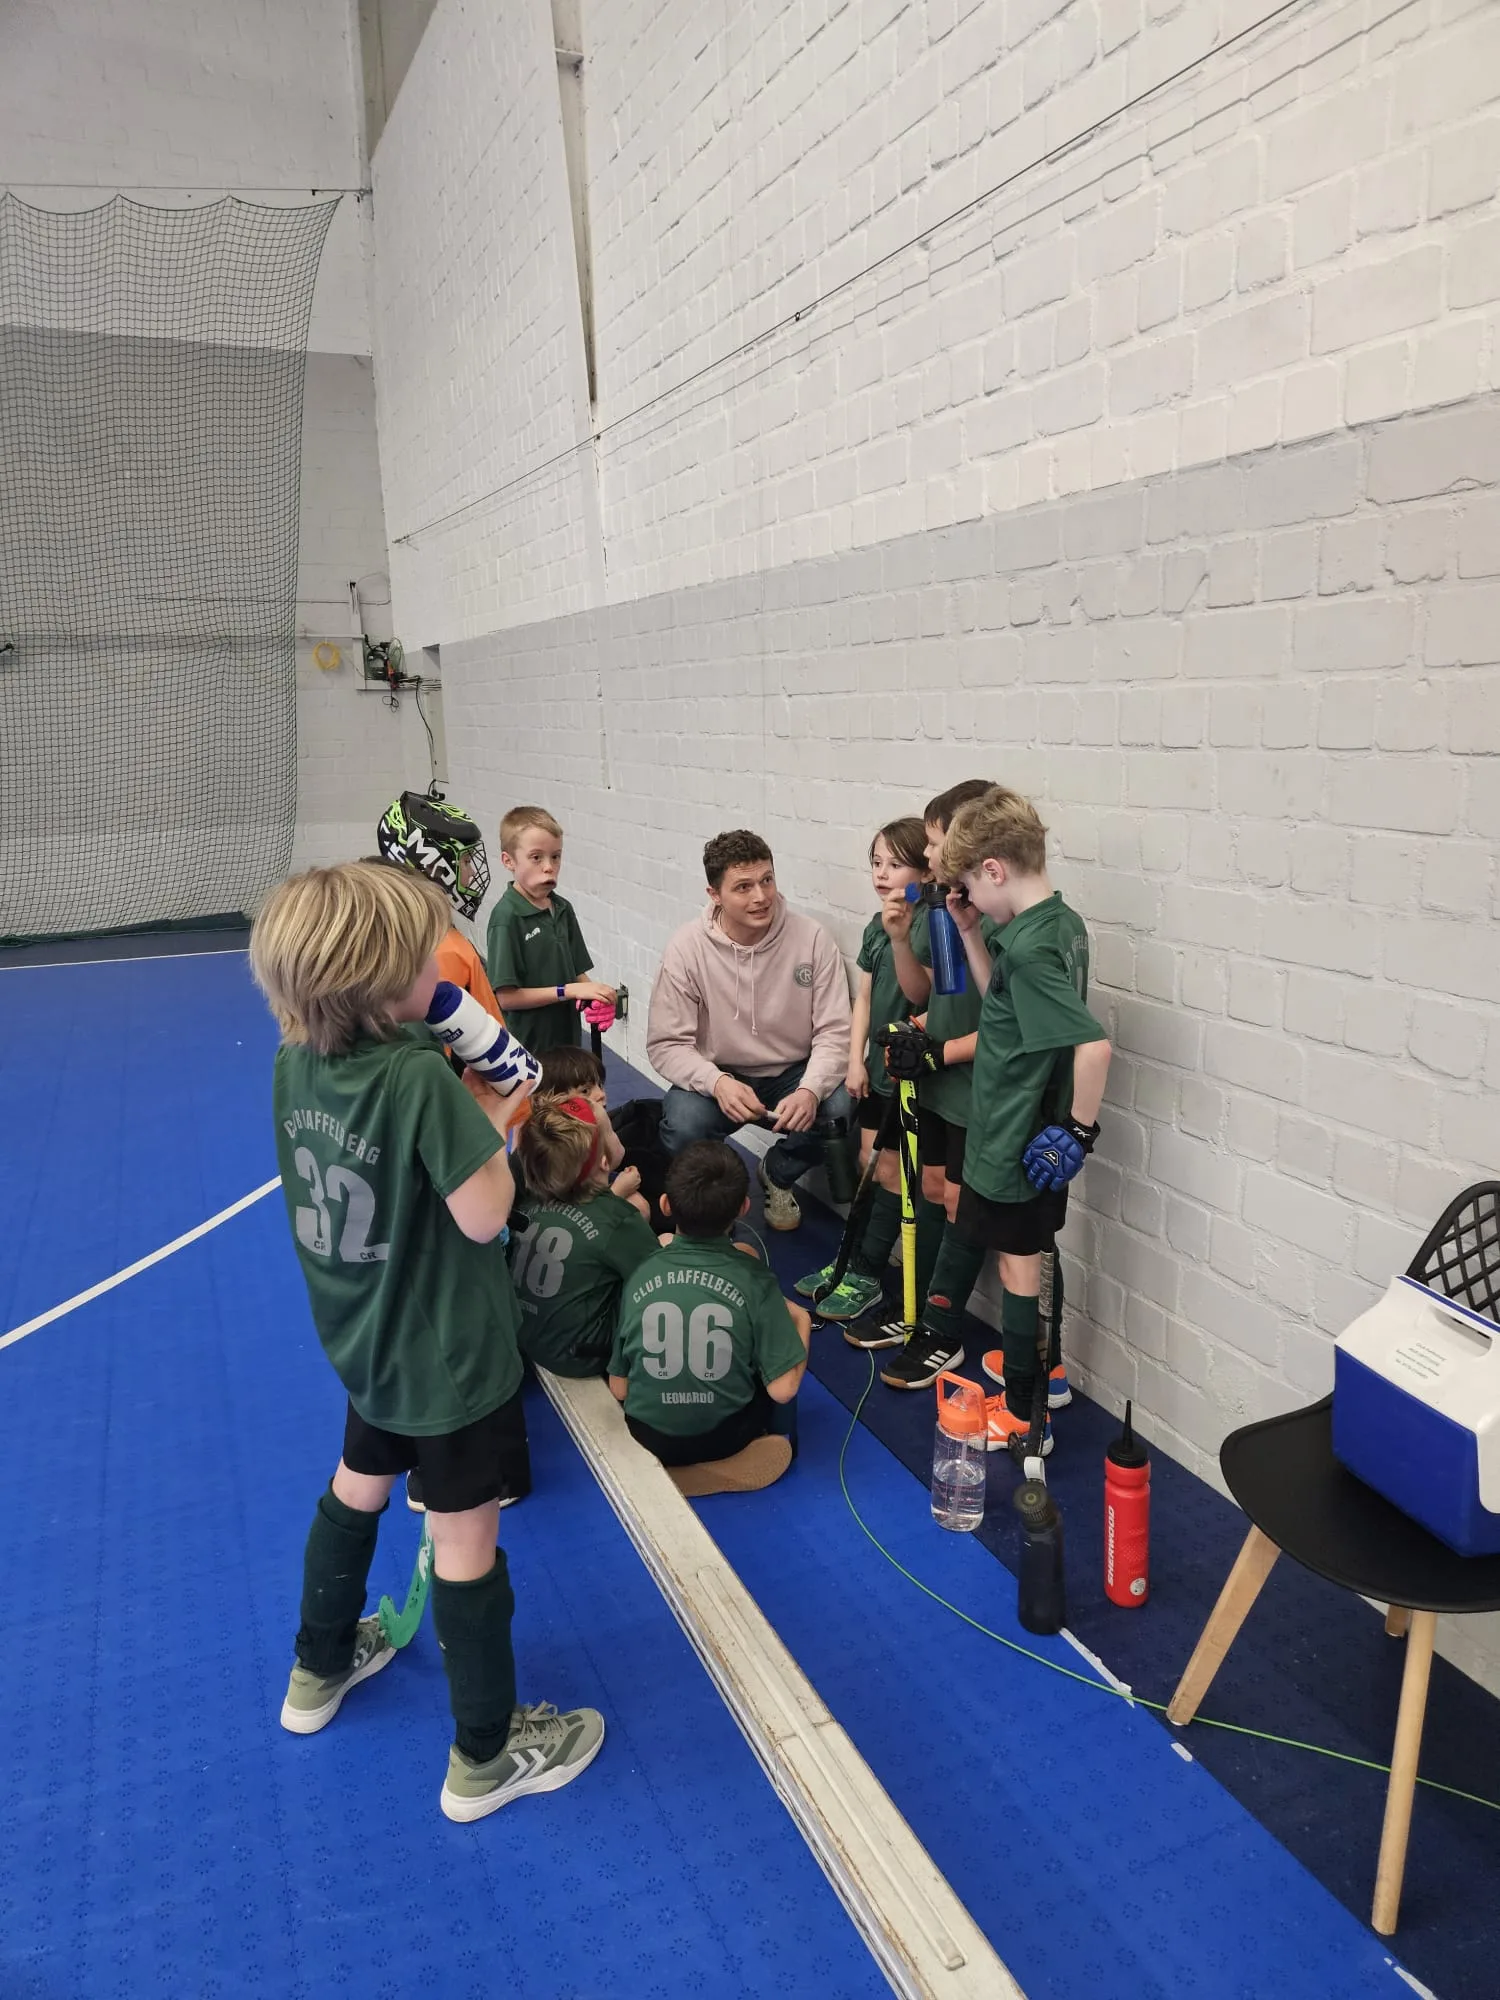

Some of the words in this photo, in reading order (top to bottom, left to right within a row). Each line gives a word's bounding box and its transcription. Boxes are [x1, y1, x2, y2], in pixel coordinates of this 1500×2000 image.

[294, 1146, 391, 1263] 32
[542, 1203, 599, 1240] FELBERG
[360, 1251, 376, 1260] CR
[512, 1222, 574, 1298] 18
[632, 1275, 663, 1303] CLUB
[641, 1301, 734, 1382] 96
[661, 1391, 715, 1404] LEONARDO
[1107, 1504, 1115, 1587] SHERWOOD
